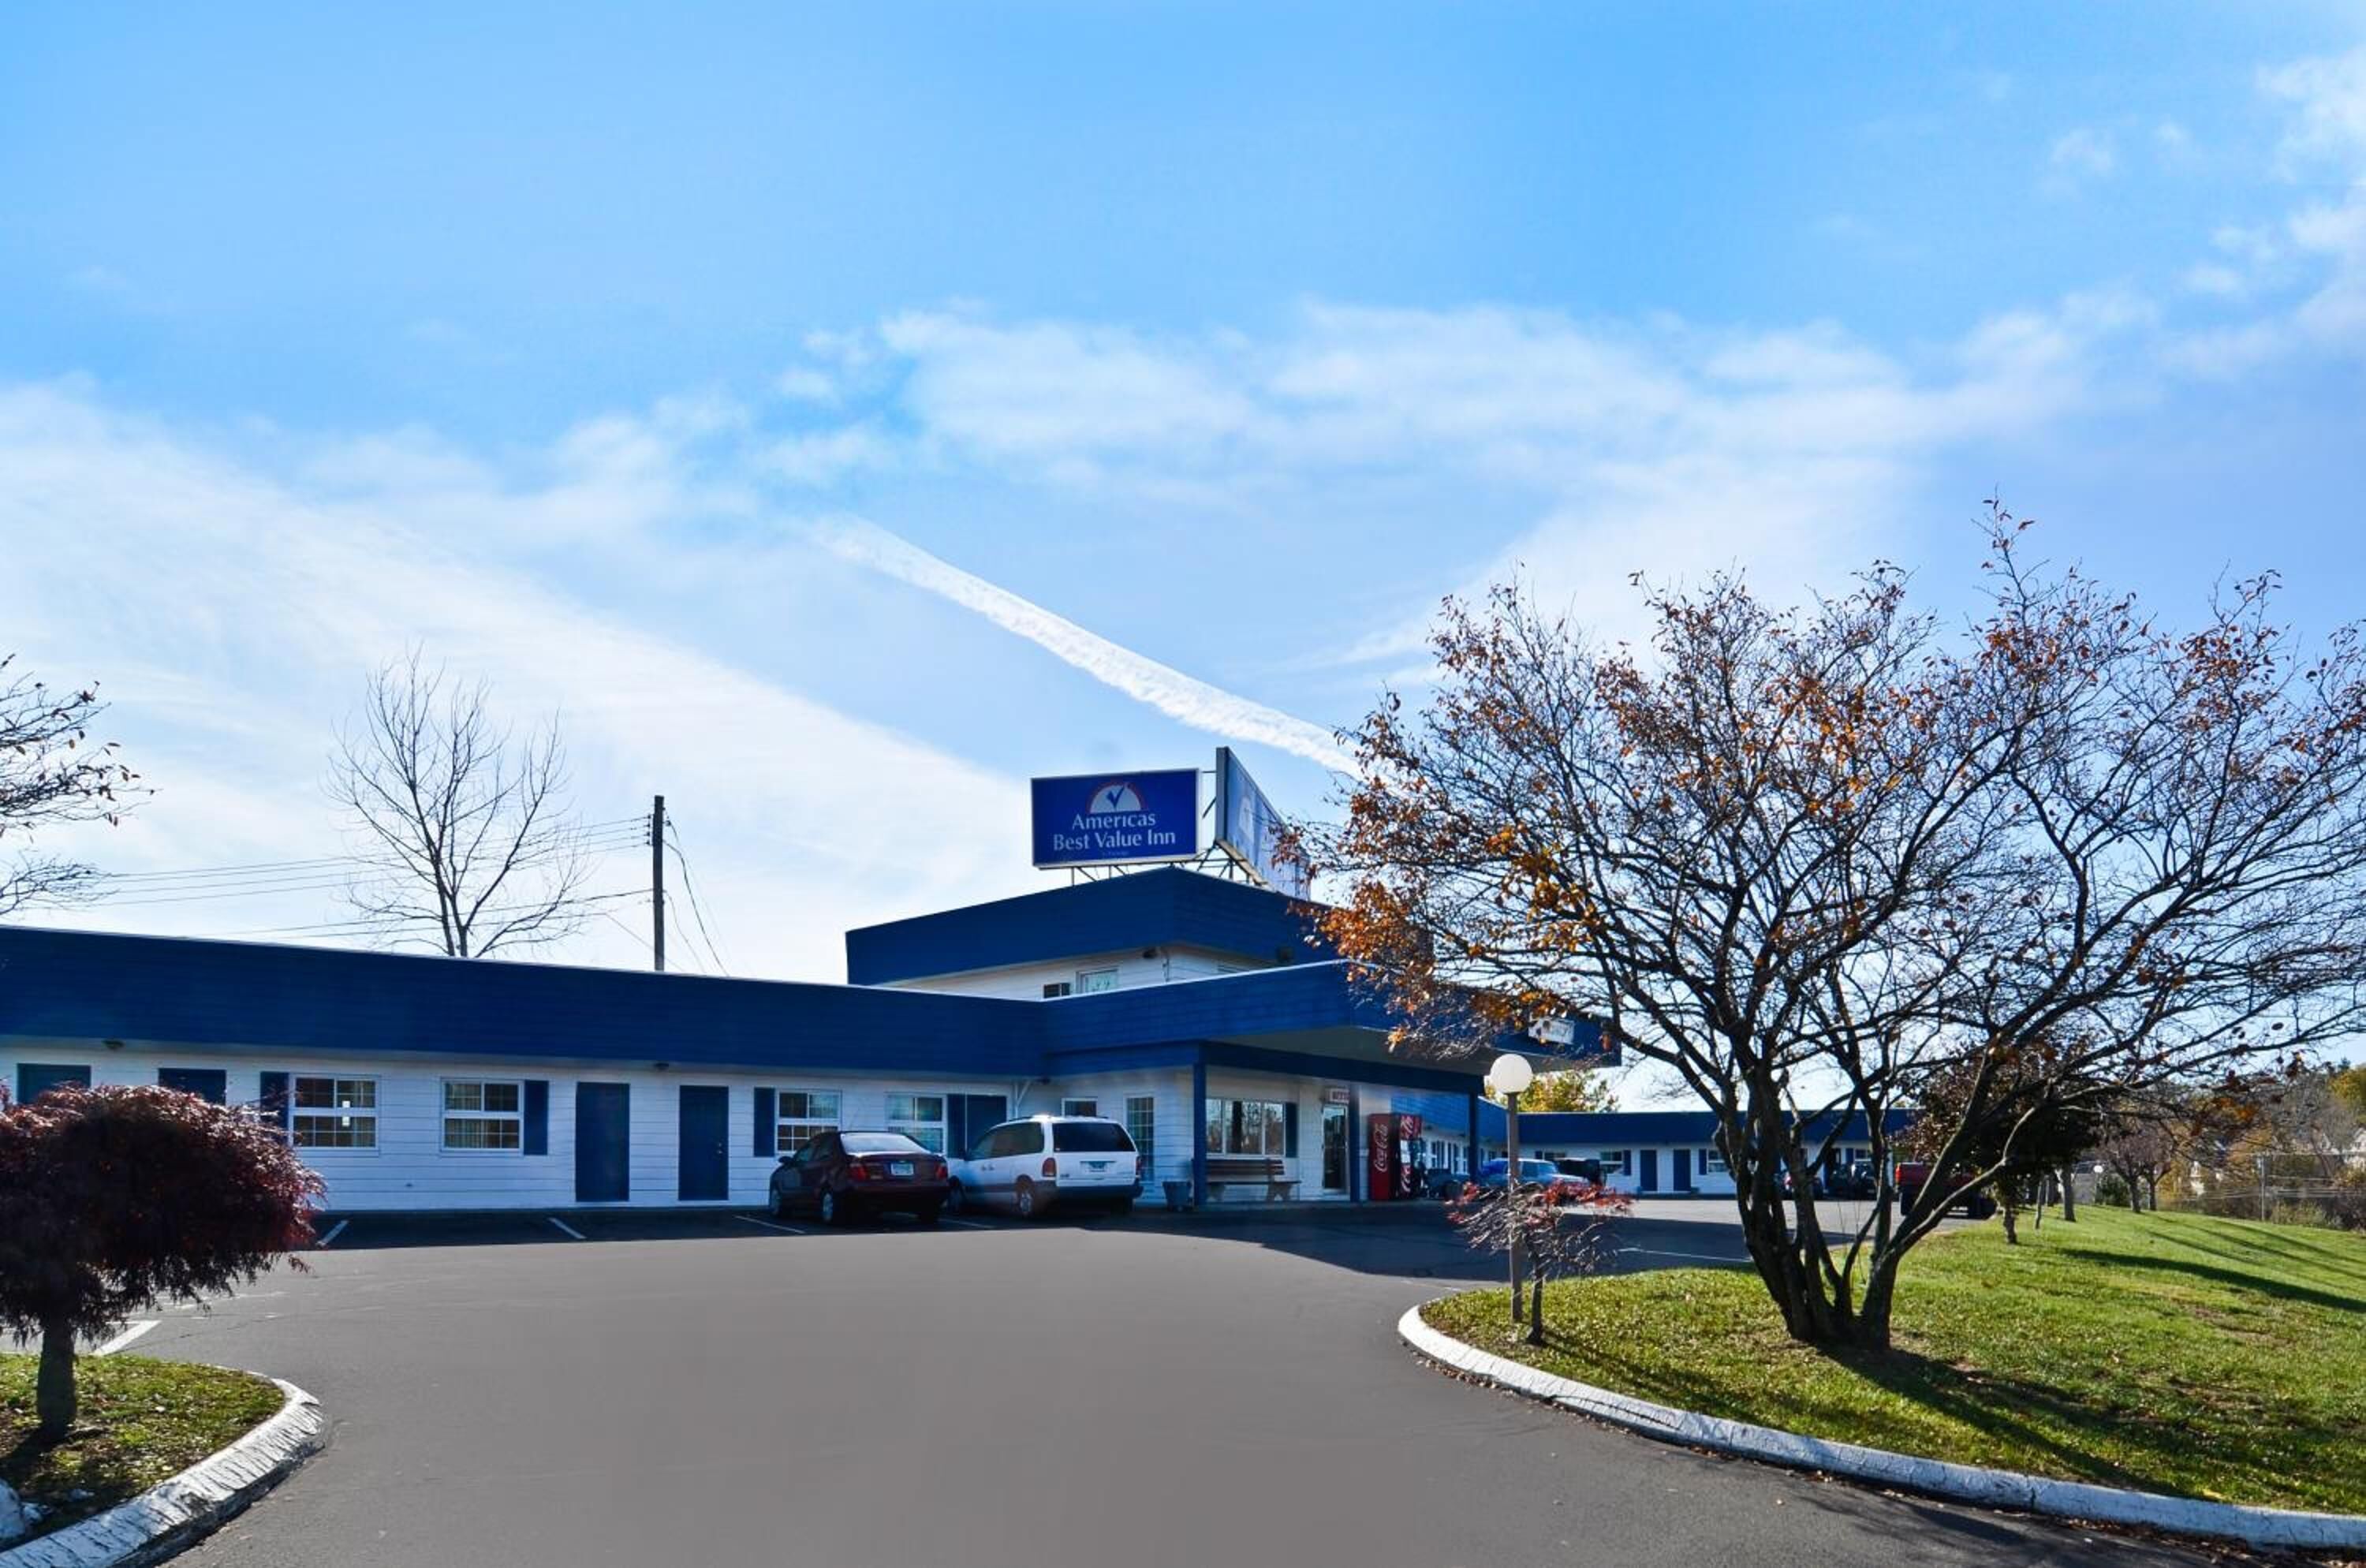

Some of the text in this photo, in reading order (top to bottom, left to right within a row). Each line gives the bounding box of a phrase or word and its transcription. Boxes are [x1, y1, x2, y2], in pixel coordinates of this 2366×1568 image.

[1072, 812, 1156, 831] Americas
[1053, 829, 1176, 851] Best Value Inn
